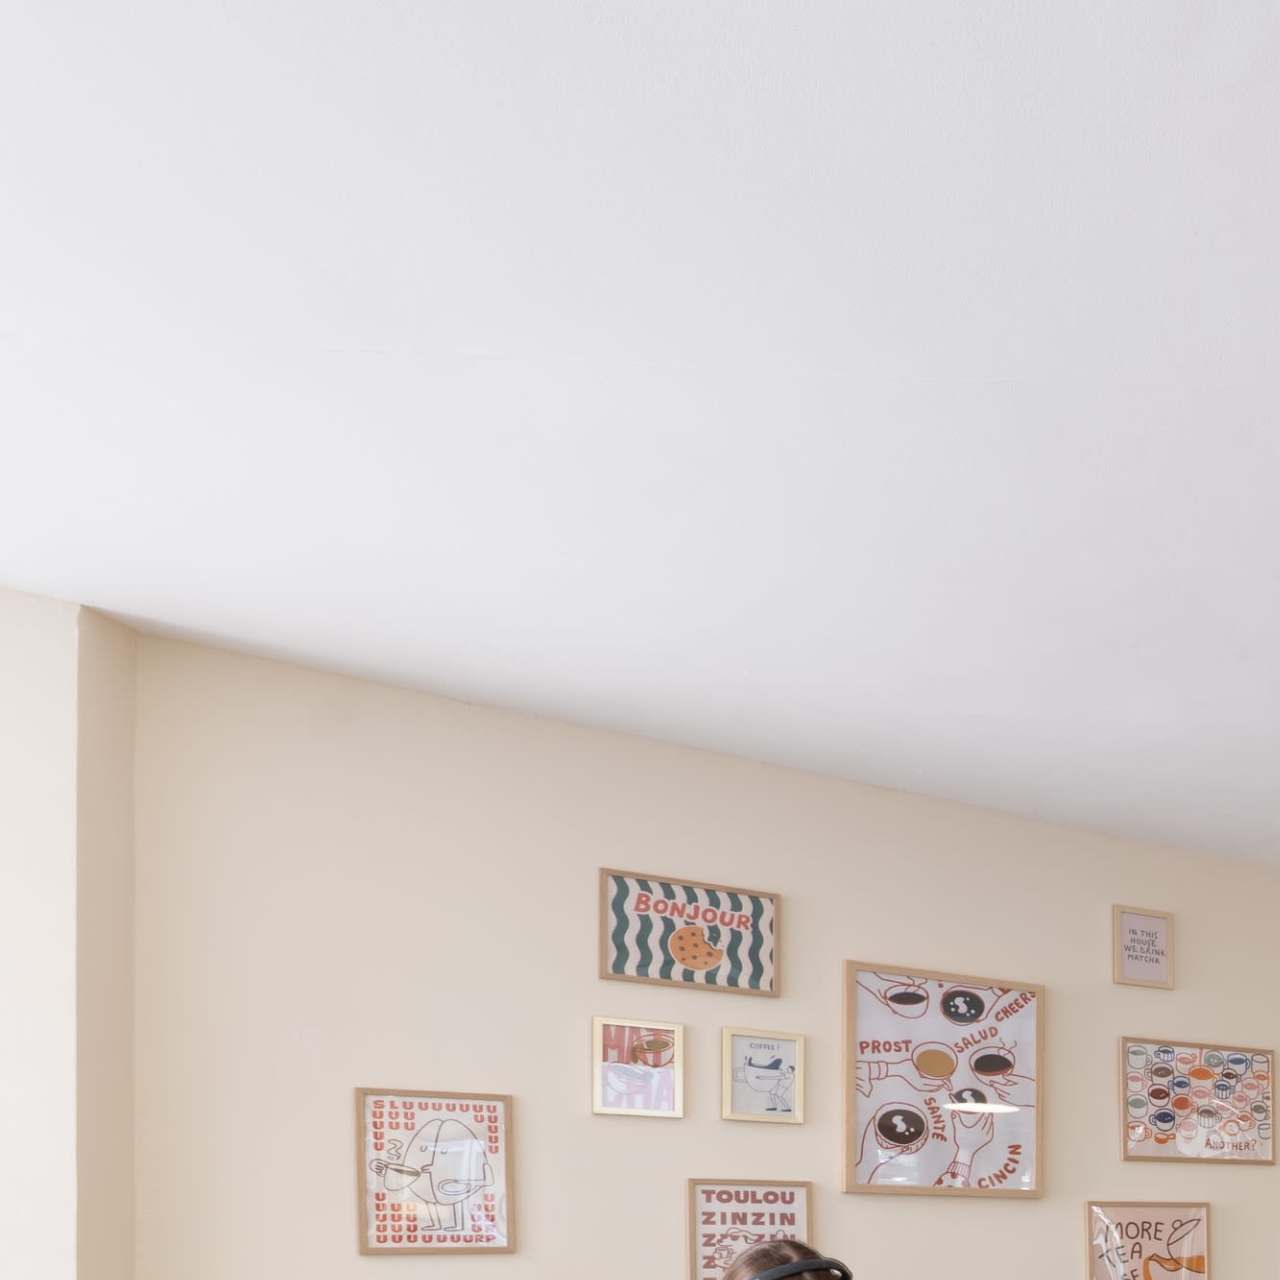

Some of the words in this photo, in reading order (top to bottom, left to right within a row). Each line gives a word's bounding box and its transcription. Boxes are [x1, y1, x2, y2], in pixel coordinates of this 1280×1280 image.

[634, 893, 750, 930] BONJOUR
[1127, 954, 1160, 964] MATCHA
[859, 1040, 912, 1054] PROST
[955, 1026, 999, 1053] SALUD
[924, 1097, 948, 1143] SANTÉ
[1205, 1138, 1257, 1152] ANOTHER?
[977, 1144, 1022, 1189] CINCIN
[702, 1190, 795, 1204] TOULOU
[702, 1212, 796, 1226] ZINZIN
[1105, 1221, 1165, 1241] MORE
[1098, 1241, 1143, 1268] TEA
